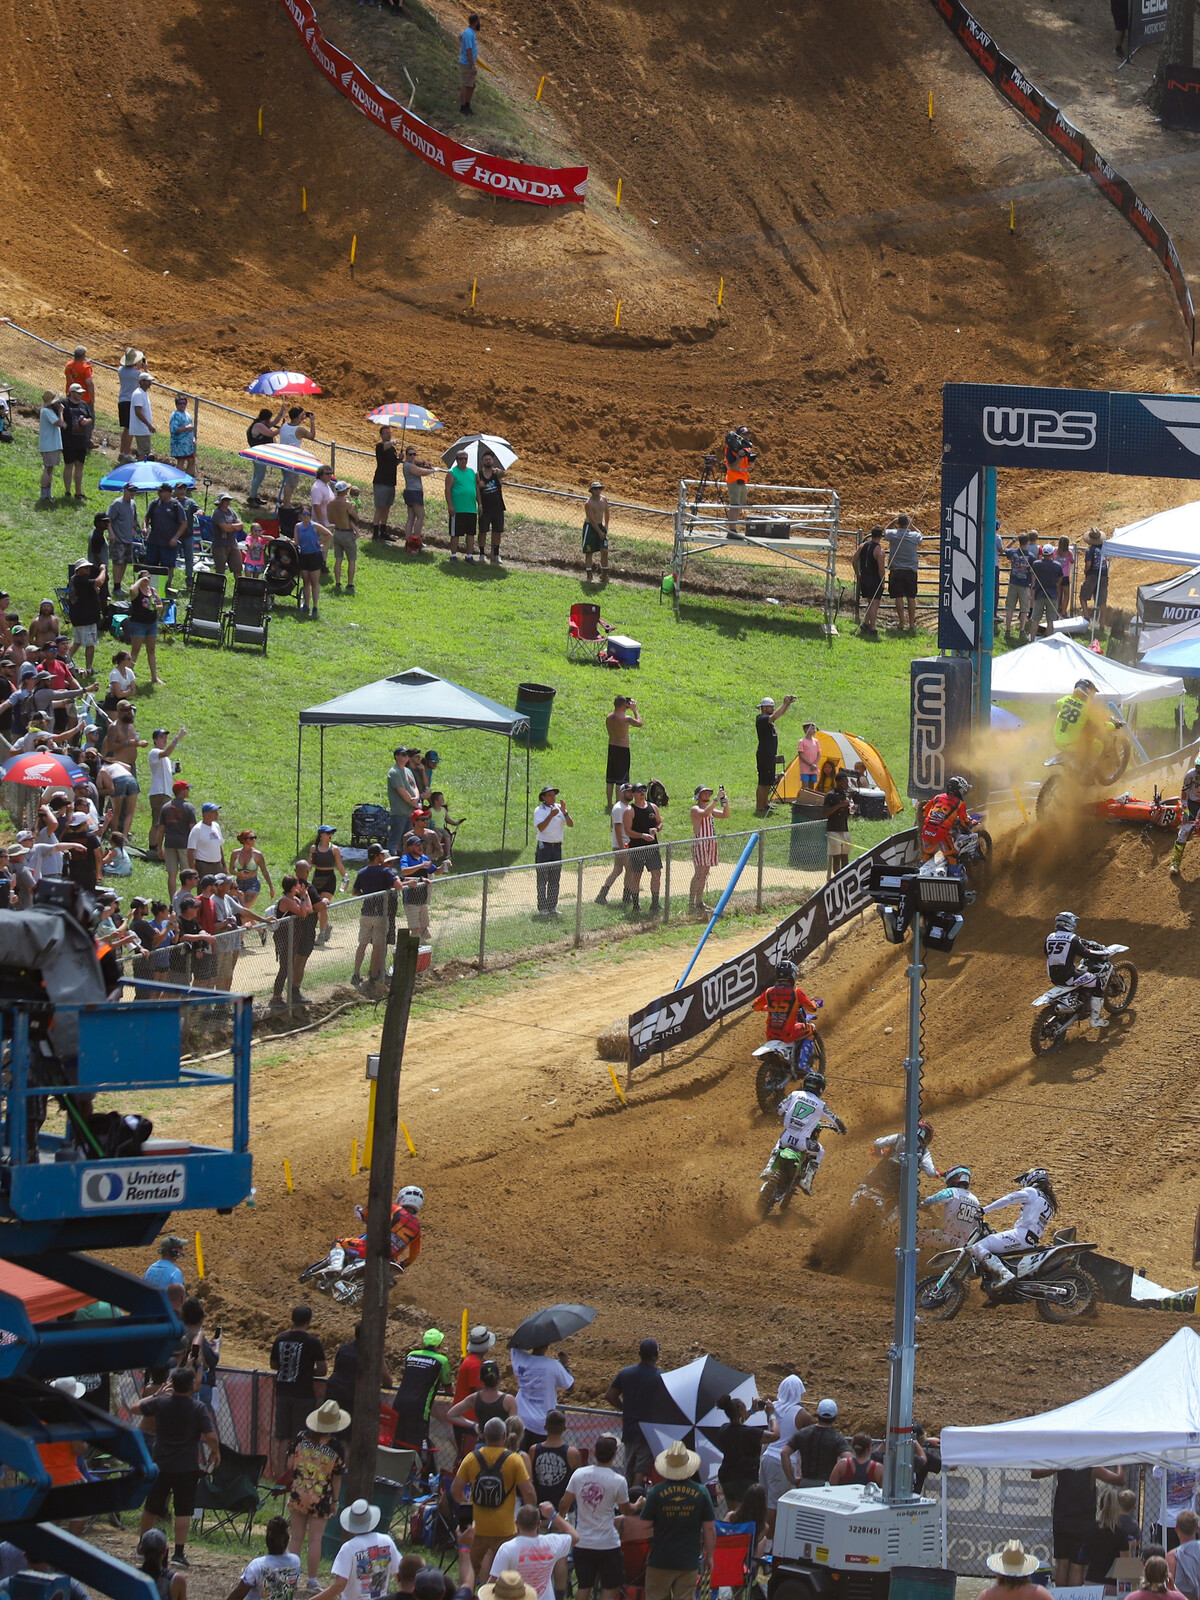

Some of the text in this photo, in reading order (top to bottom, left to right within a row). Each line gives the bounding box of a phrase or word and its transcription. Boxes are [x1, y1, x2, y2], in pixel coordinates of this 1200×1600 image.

[351, 79, 387, 124] HONDA
[402, 124, 446, 167] HONDA
[473, 166, 565, 199] HONDA
[982, 406, 1097, 450] WPS
[943, 506, 953, 607] RACING
[951, 471, 979, 647] FLY
[1060, 704, 1082, 724] 28
[913, 673, 945, 791] WPS
[896, 894, 906, 932] TRIME
[764, 906, 816, 966] FLY
[1047, 941, 1067, 955] 55
[702, 953, 758, 1020] WPS
[630, 995, 695, 1046] FLY
[791, 1100, 816, 1120] 17
[787, 1134, 800, 1147] FLY
[127, 1169, 176, 1186] United
[126, 1185, 180, 1201] Rentals
[957, 1202, 978, 1223] 309
[1031, 1251, 1047, 1265] 27
[406, 1355, 437, 1366] Kawasaki
[848, 1525, 881, 1535] 32201451
[355, 1550, 370, 1562] THE
